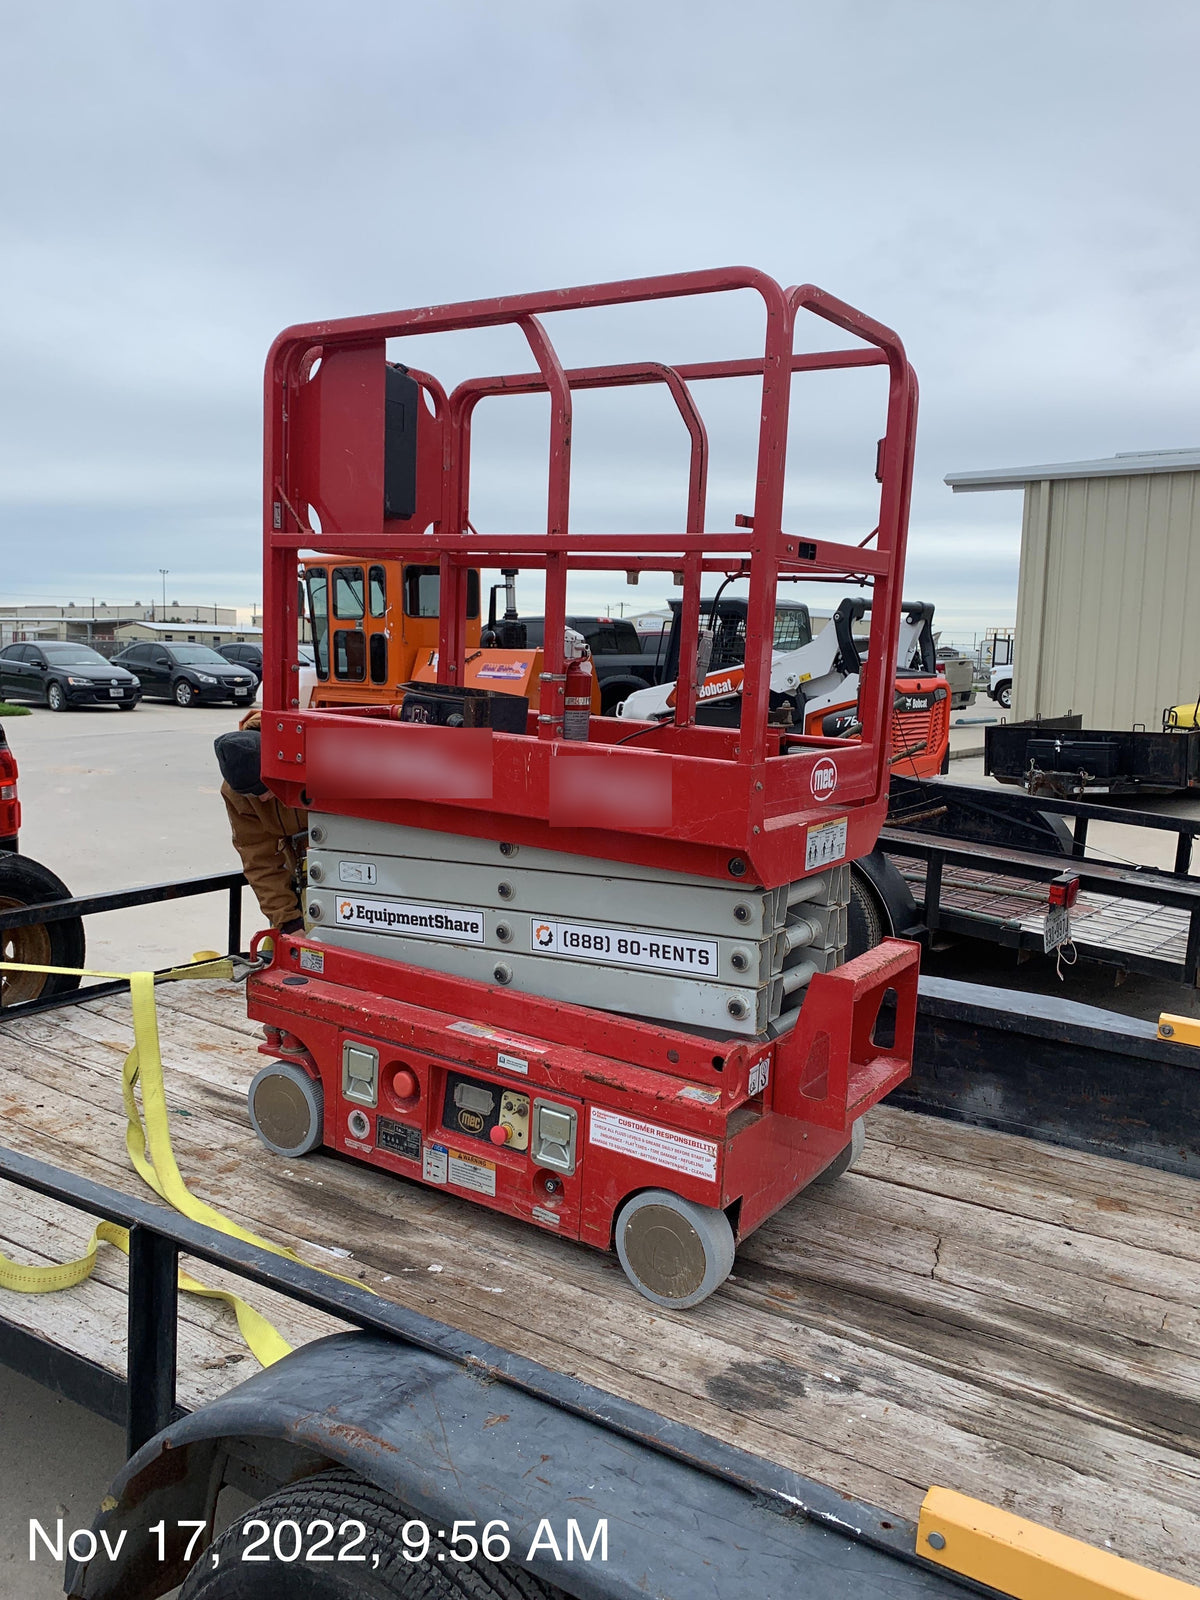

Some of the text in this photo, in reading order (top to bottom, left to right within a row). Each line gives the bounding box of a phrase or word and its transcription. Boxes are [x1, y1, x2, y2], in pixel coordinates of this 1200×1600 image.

[700, 678, 733, 698] Bobcat
[912, 698, 928, 709] Bobcat
[356, 905, 480, 934] EquipmentShare
[563, 930, 711, 967] (888) 80-RENTS
[619, 1119, 715, 1153] CUSTOMER RESPONSIBILITY
